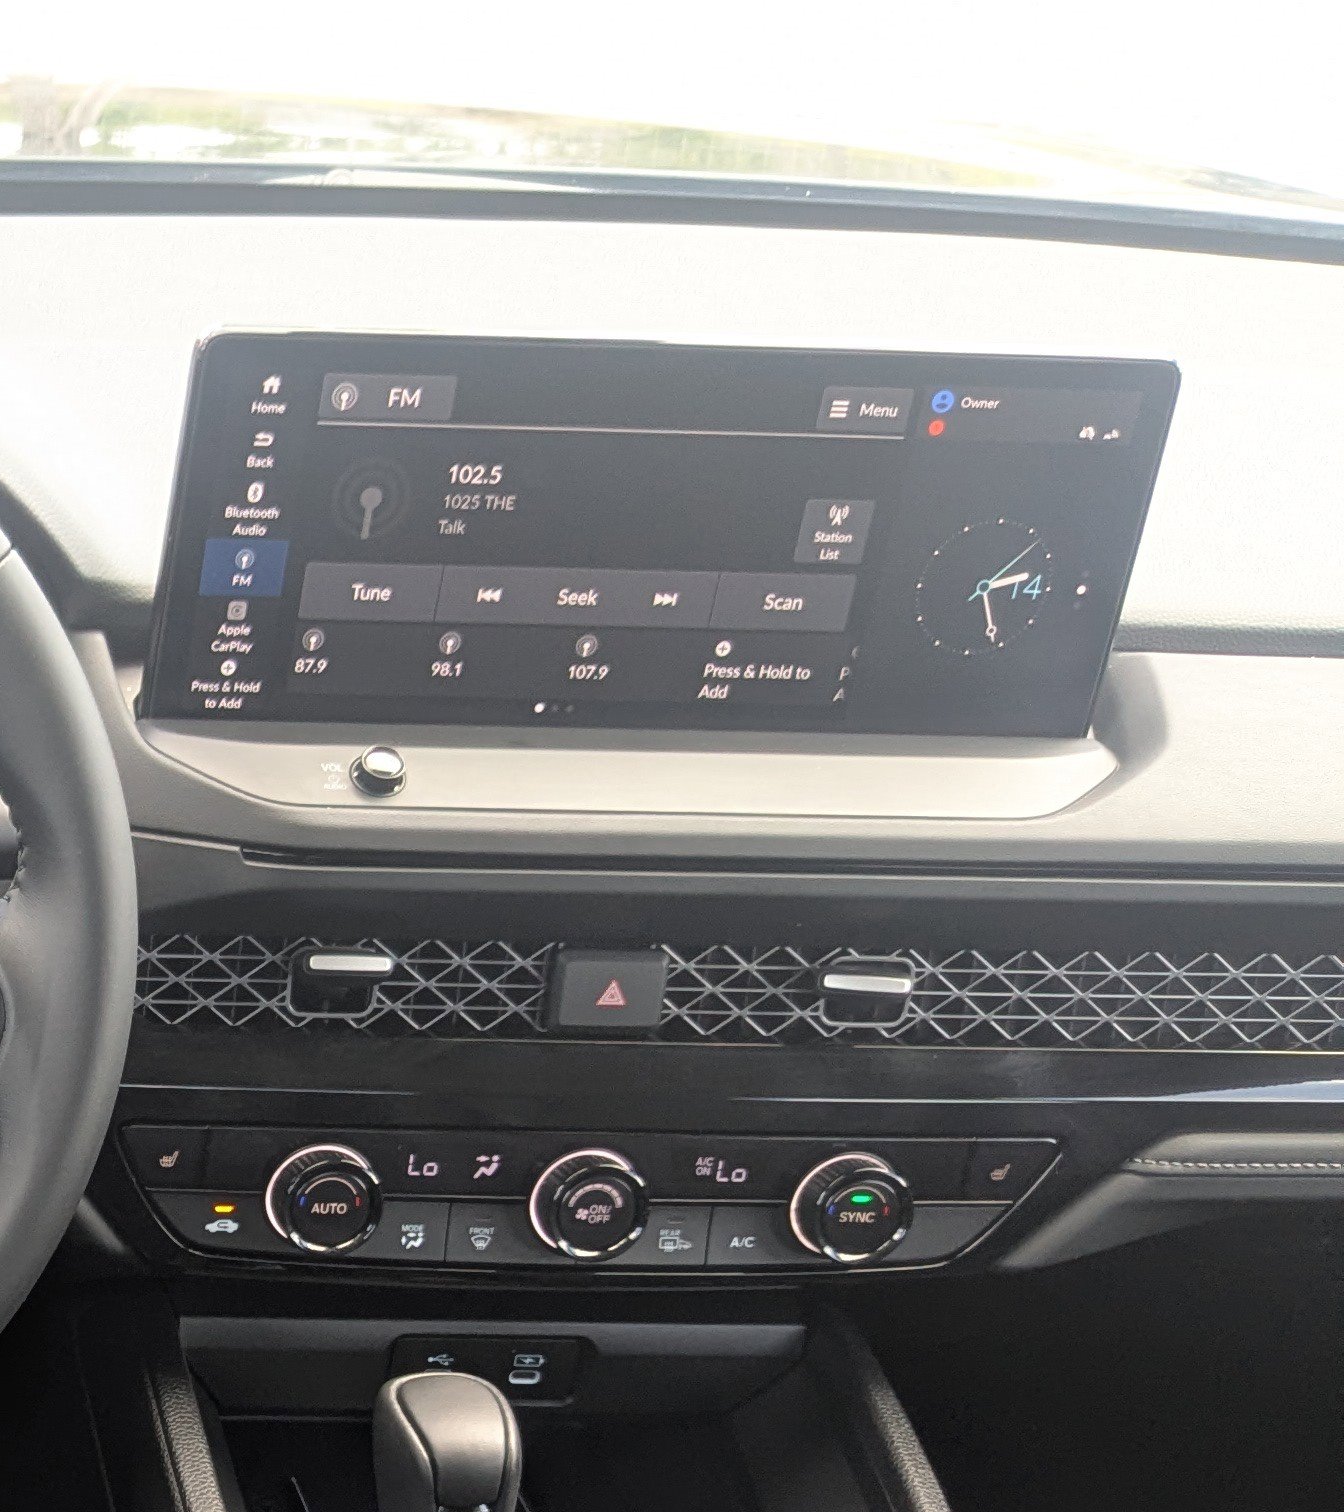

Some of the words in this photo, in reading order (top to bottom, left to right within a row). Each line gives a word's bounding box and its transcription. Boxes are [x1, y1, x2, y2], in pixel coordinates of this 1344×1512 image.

[387, 387, 423, 408] FM
[961, 397, 1000, 410] Owner
[250, 401, 286, 414] Home
[859, 402, 899, 418] Menu
[246, 455, 274, 468] Back
[448, 464, 503, 484] 102.5
[444, 494, 480, 510] 1025
[484, 494, 516, 511] THE
[224, 505, 280, 519] Bluetooth
[232, 523, 267, 536] Audio
[438, 519, 466, 535] Talk
[814, 531, 853, 543] Station
[819, 549, 840, 560] List
[231, 574, 253, 587] FM
[351, 583, 392, 602] Tune
[556, 588, 599, 606] Seek
[763, 593, 803, 611] Scan
[217, 623, 252, 637] Apple
[211, 640, 253, 654] CarPlay
[294, 657, 328, 674] 87.9
[431, 661, 463, 677] 98.1
[568, 664, 610, 680] 107.9
[703, 662, 741, 678] Press
[743, 664, 755, 679] &
[758, 664, 794, 680] Hold
[795, 666, 811, 680] to
[190, 680, 219, 693] Press
[221, 681, 231, 693] &
[233, 680, 261, 693] Hold
[697, 684, 730, 699] Add
[204, 697, 216, 709] to
[218, 697, 243, 709] Add
[695, 1157, 715, 1167] A/C
[696, 1167, 711, 1176] ON
[311, 1202, 348, 1215] AUTO
[588, 1215, 610, 1224] OFF
[839, 1211, 876, 1223] SYNC
[469, 1226, 494, 1235] FRONT
[730, 1236, 756, 1248] A/C
